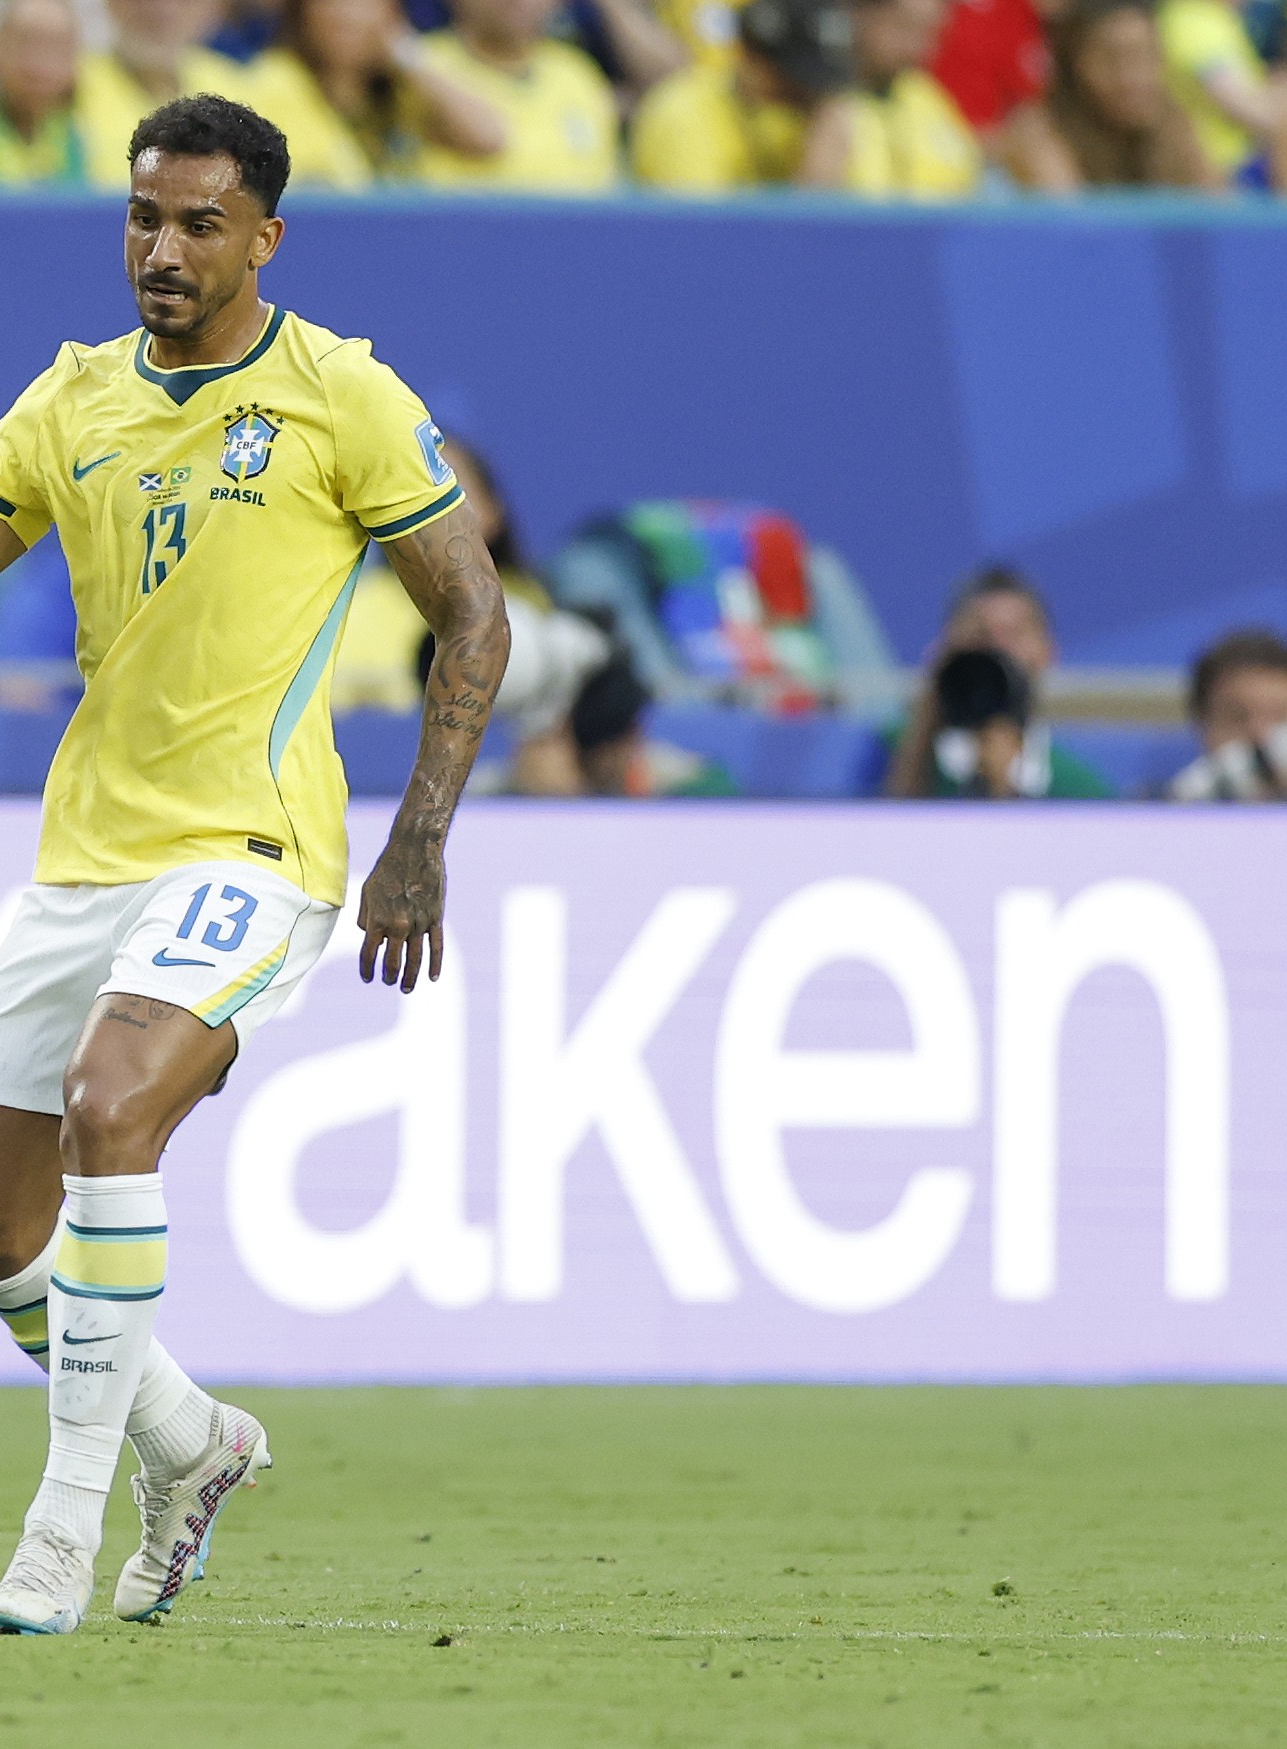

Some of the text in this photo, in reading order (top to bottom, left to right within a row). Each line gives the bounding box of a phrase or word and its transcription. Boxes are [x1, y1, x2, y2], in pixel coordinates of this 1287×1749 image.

[236, 441, 257, 450] CBF
[209, 487, 266, 507] BRASIL
[141, 502, 187, 594] 13
[176, 883, 259, 952] 13
[61, 1357, 118, 1373] BRASIL
